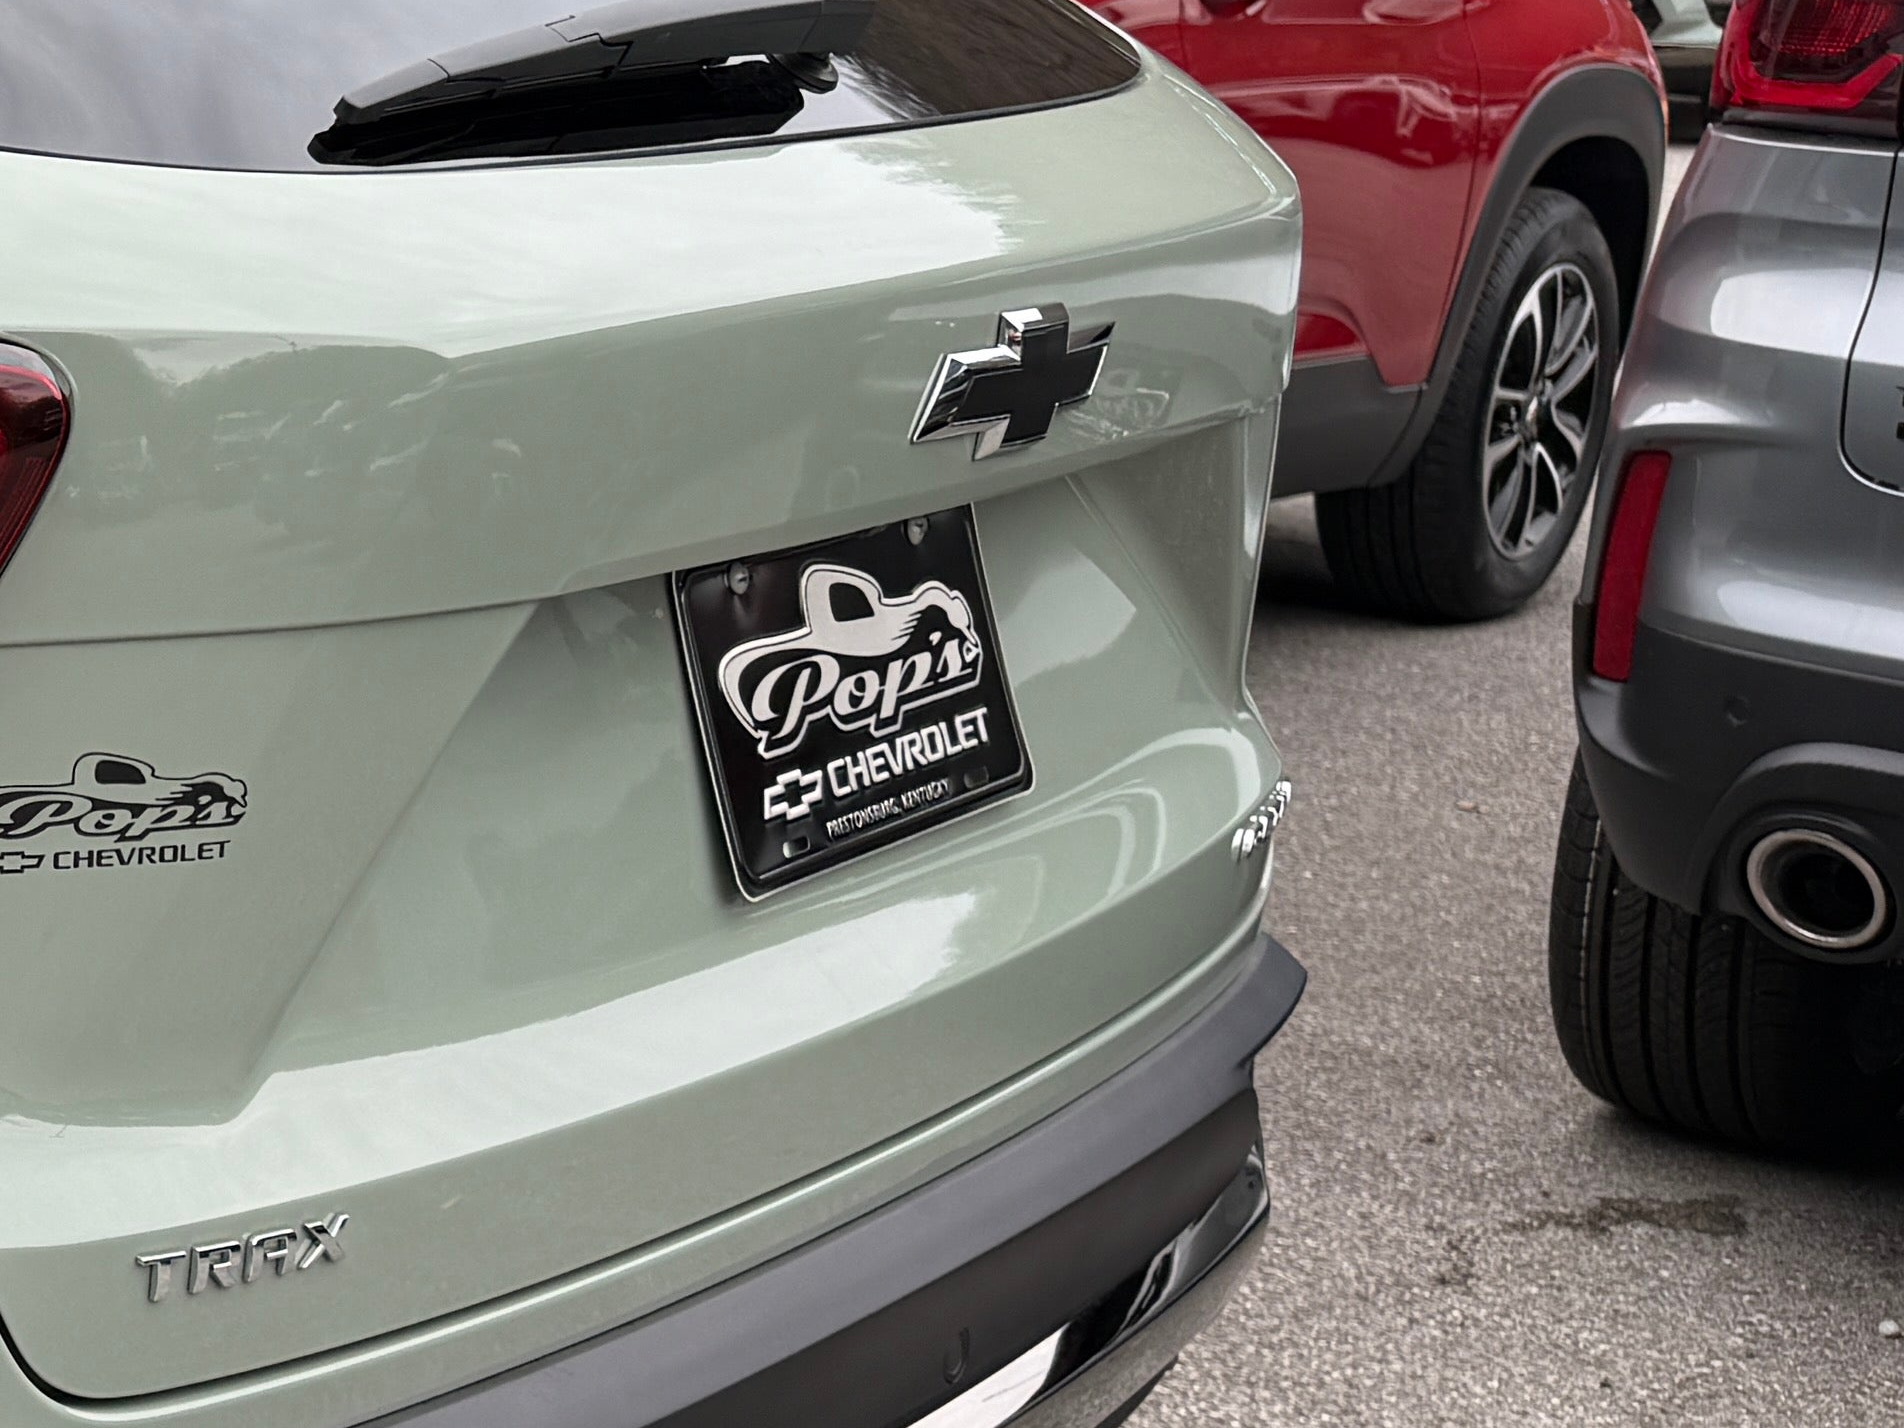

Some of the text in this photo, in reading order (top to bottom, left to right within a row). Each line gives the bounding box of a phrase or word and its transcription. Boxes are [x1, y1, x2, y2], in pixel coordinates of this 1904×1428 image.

[750, 632, 974, 739] Pop's
[827, 707, 990, 798] CHEVROLET
[52, 839, 231, 870] CHEVROLET
[135, 1211, 350, 1303] TRAX
